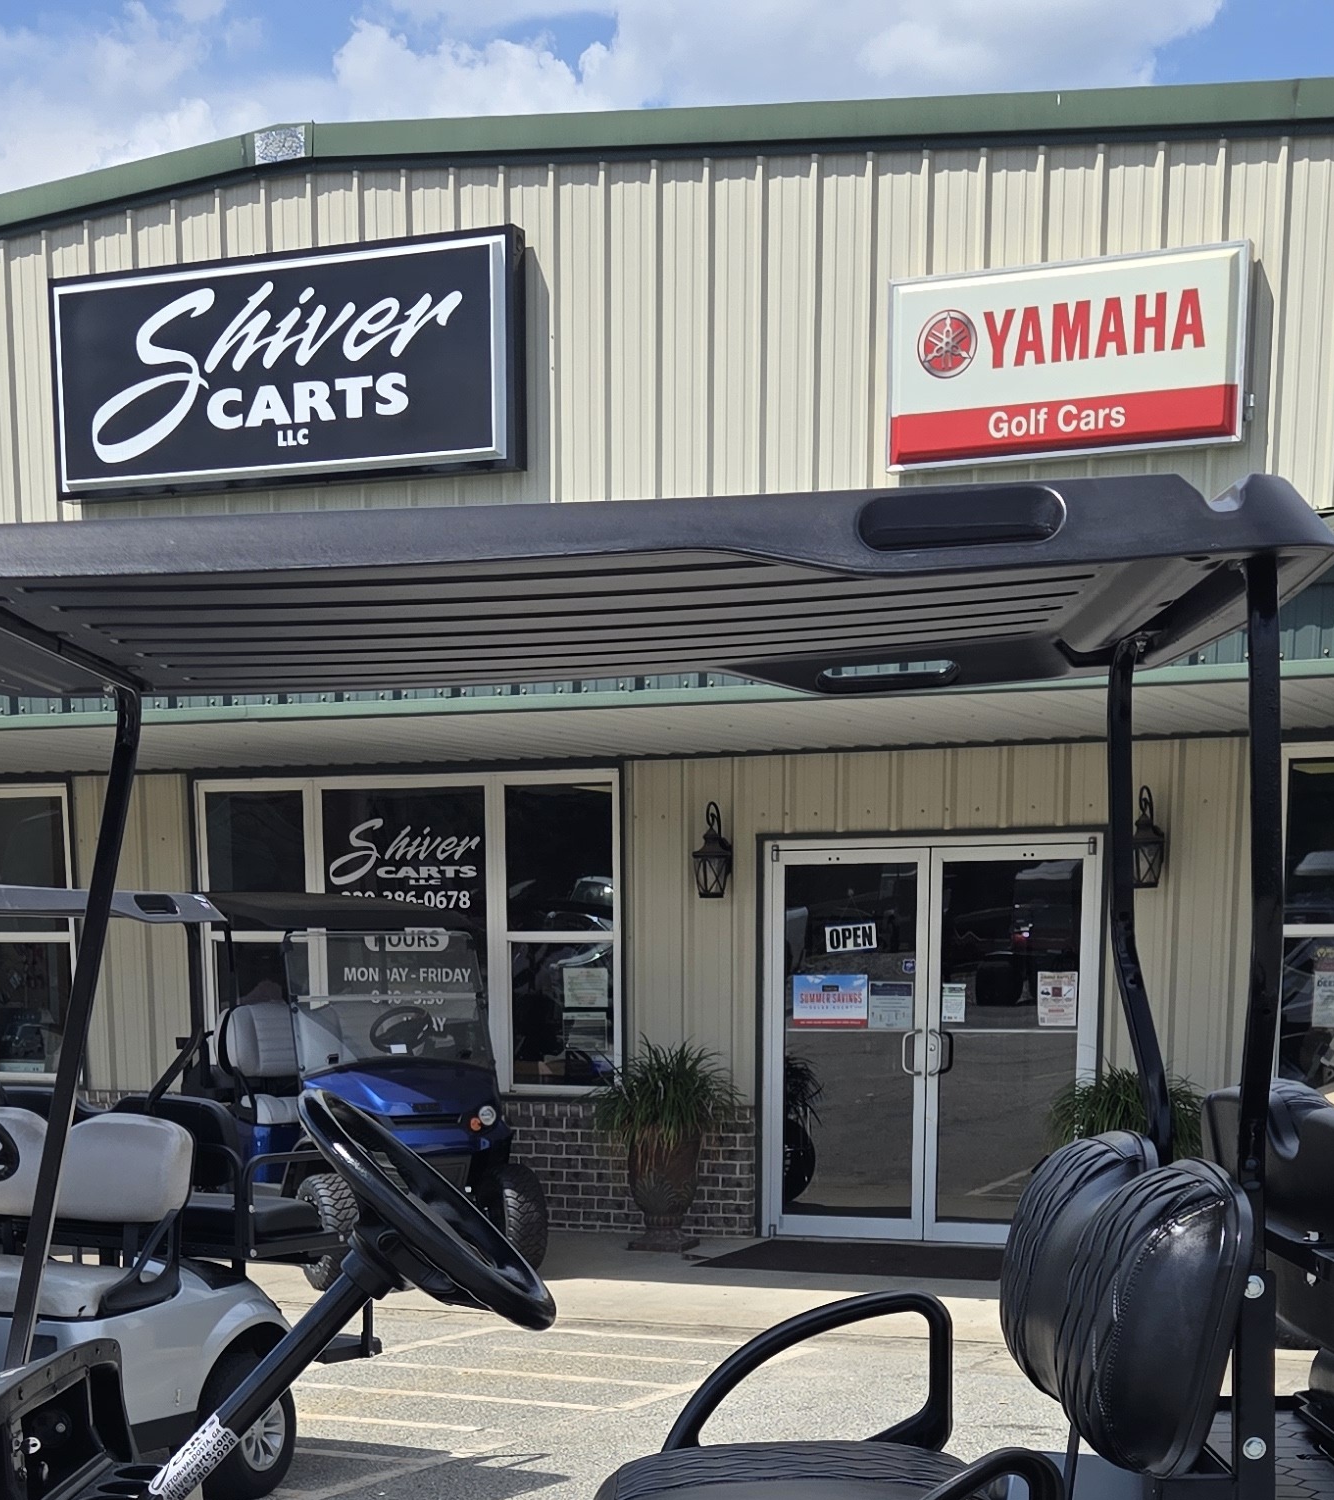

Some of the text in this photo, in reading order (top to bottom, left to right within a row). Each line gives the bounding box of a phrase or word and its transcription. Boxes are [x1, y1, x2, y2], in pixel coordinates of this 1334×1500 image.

[983, 288, 1206, 369] YAMAHA
[91, 280, 463, 464] Shiver
[206, 372, 409, 430] CARTS
[988, 404, 1126, 439] Golf Cars
[277, 428, 309, 447] LLC
[330, 818, 481, 885] Shiver
[376, 866, 477, 878] CARTS
[829, 925, 873, 949] OPEN
[343, 967, 409, 982] MONAY
[419, 968, 471, 983] FRIDAY
[800, 992, 863, 1004] SUMMER SAVINGS
[211, 1427, 221, 1439] GA
